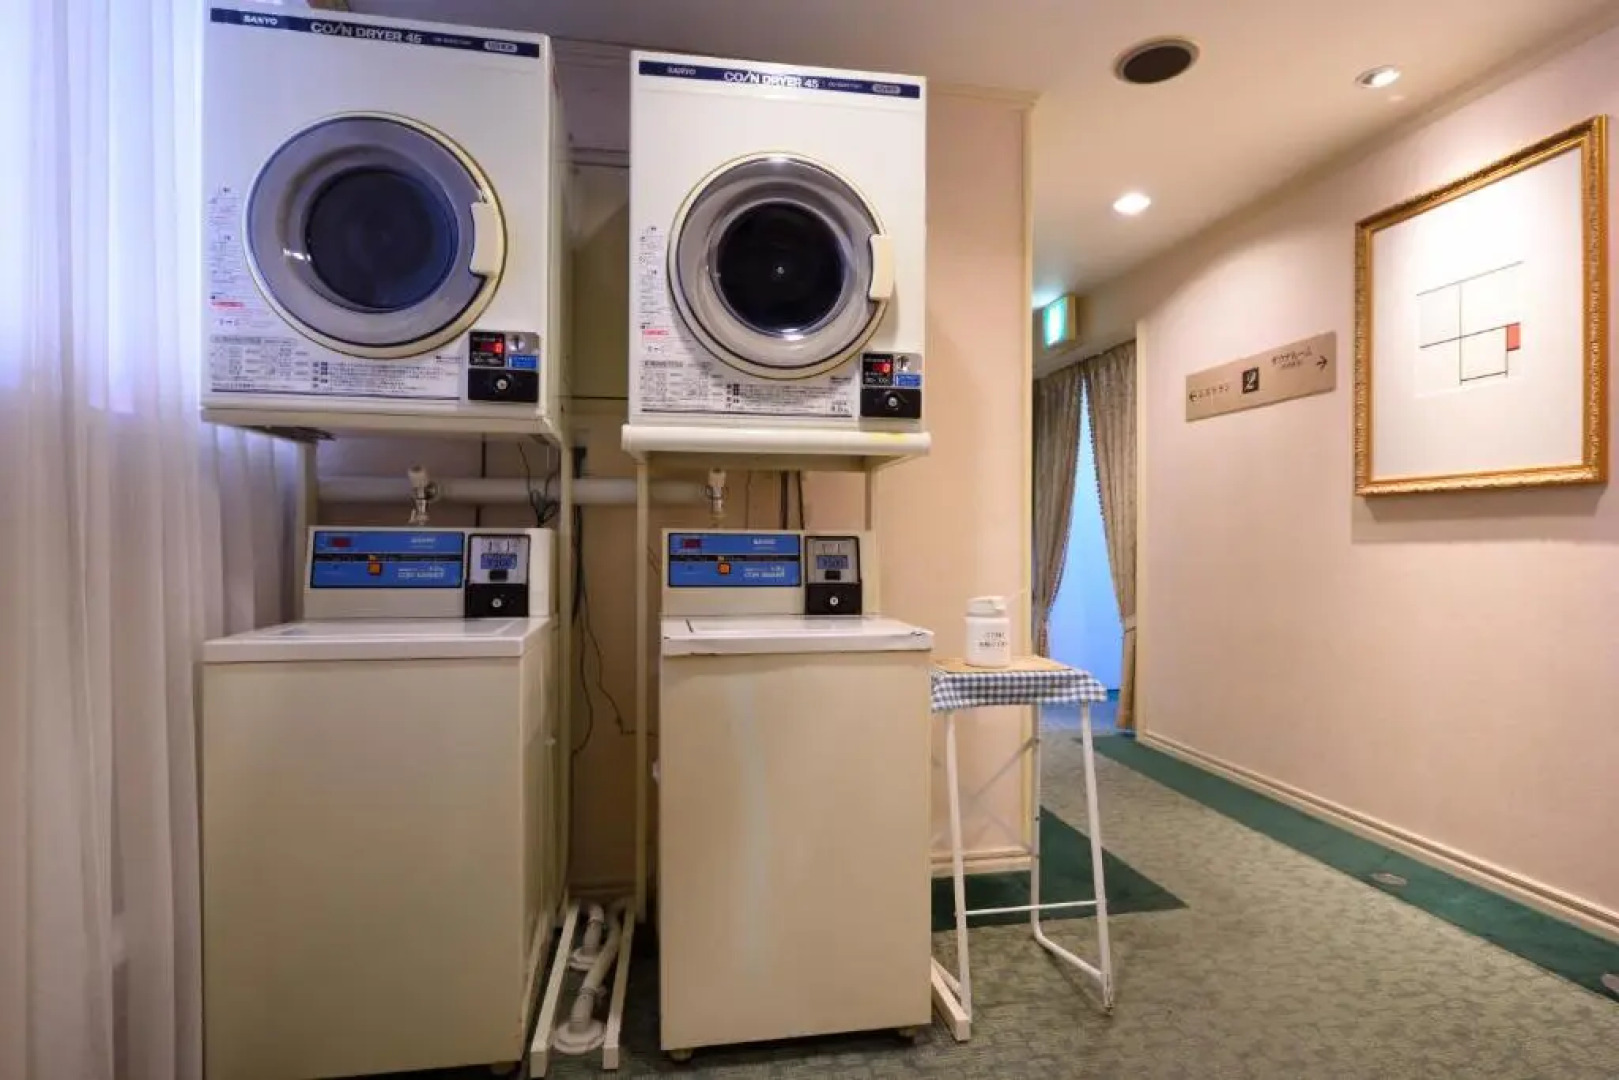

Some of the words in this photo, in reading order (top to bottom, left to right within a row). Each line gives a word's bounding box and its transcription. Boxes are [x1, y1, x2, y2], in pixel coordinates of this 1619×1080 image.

[243, 14, 278, 26] SANYO
[356, 26, 402, 41] DRYER
[405, 33, 422, 44] 45
[803, 78, 820, 89] 45
